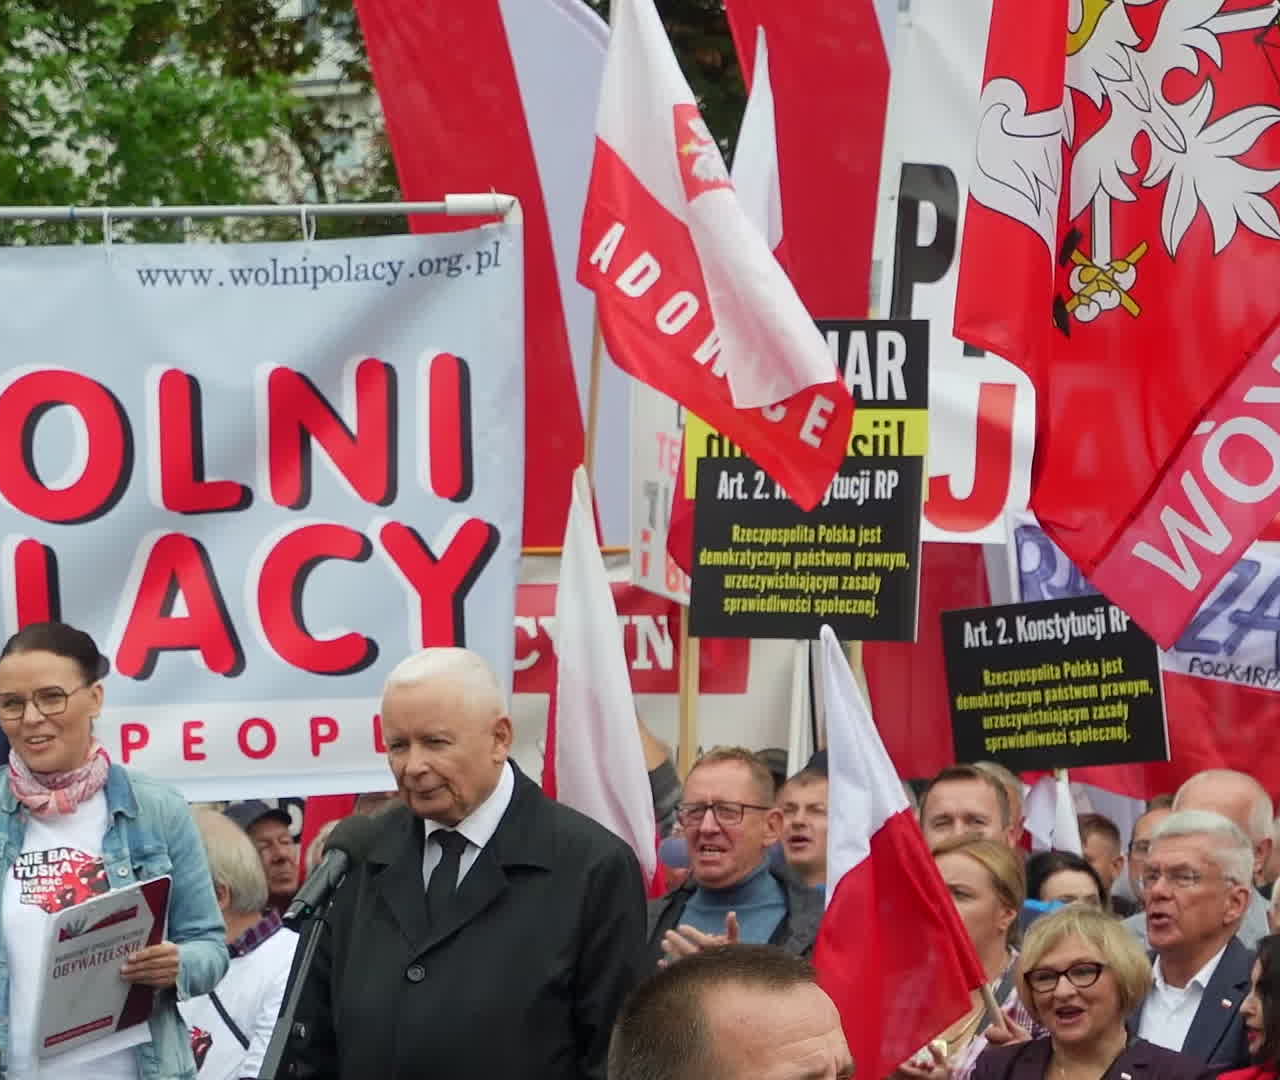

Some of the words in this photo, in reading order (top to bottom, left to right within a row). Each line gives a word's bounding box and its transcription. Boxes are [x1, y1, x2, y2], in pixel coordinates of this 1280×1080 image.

[135, 241, 501, 291] www.wolnipolacy.org.pl
[717, 470, 749, 500] Art.
[753, 470, 770, 500] 2.
[874, 470, 900, 500] RP
[818, 524, 856, 543] Polska
[857, 524, 882, 547] jest
[841, 573, 882, 594] zasady
[963, 619, 993, 648] Art.
[996, 617, 1013, 645] 2.
[1015, 606, 1107, 645] Konstytucji
[15, 860, 73, 879] TUSKA
[16, 850, 44, 867] NIE
